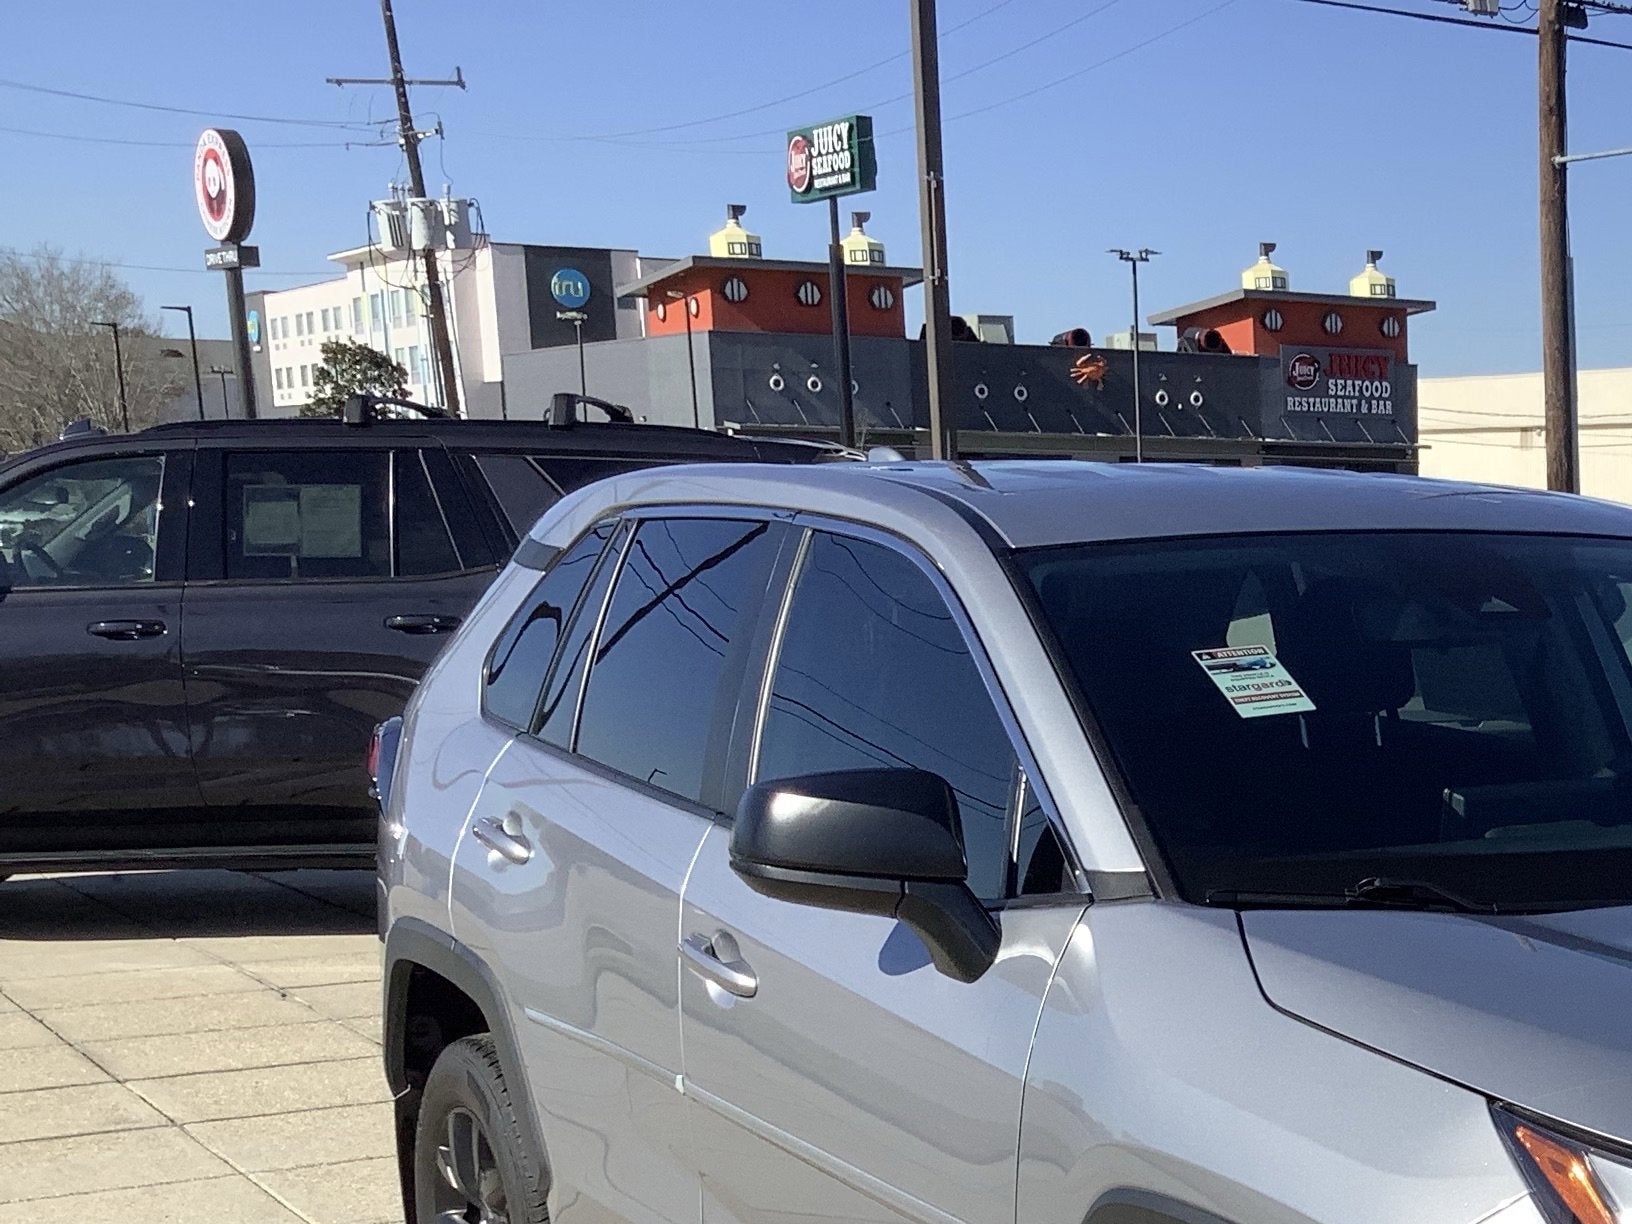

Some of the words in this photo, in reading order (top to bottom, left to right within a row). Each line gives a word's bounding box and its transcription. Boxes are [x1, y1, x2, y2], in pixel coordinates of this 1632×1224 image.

[810, 122, 849, 157] JUICY
[811, 150, 851, 176] SEAFOOD
[1323, 353, 1389, 380] JUICY
[1328, 379, 1391, 398] SEAFOOD
[1286, 396, 1358, 413] RESTAURANT
[1360, 399, 1369, 414] &
[1371, 399, 1393, 415] BAR
[1216, 647, 1266, 659] ATTENTION
